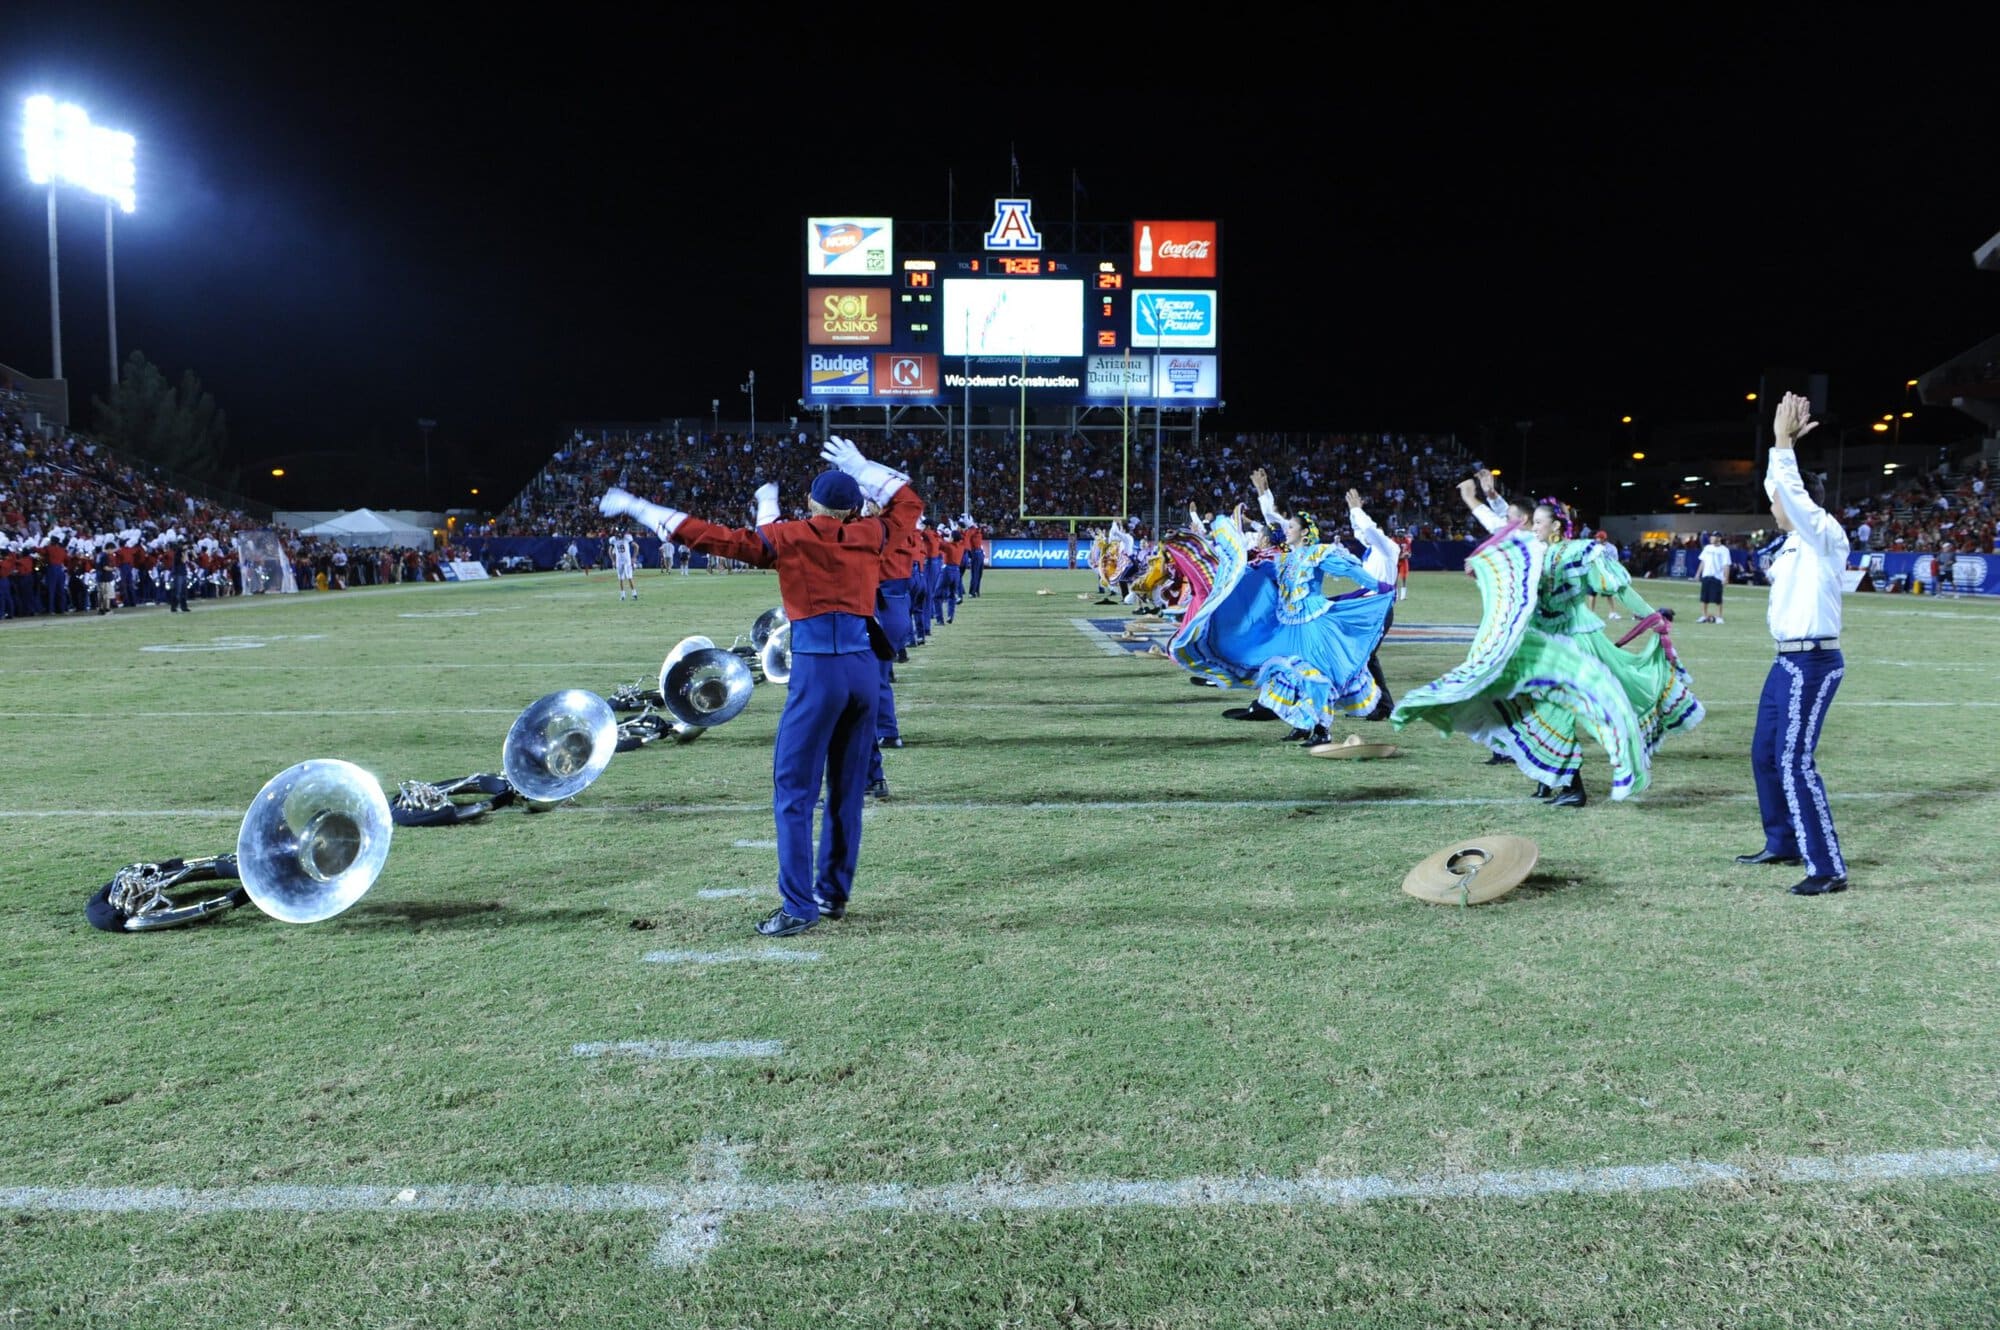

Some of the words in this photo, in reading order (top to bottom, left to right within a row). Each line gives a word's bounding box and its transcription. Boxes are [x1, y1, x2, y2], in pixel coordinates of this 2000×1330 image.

[984, 199, 1042, 250] A
[823, 295, 878, 321] SOL
[1155, 298, 1195, 310] Tucson
[1159, 309, 1204, 320] Electric
[823, 321, 878, 333] CASINOS
[1163, 319, 1204, 330] Power
[811, 354, 869, 375] Budget
[945, 375, 1007, 387] Woodward
[1008, 375, 1079, 387] Construction
[1088, 371, 1119, 384] Daily
